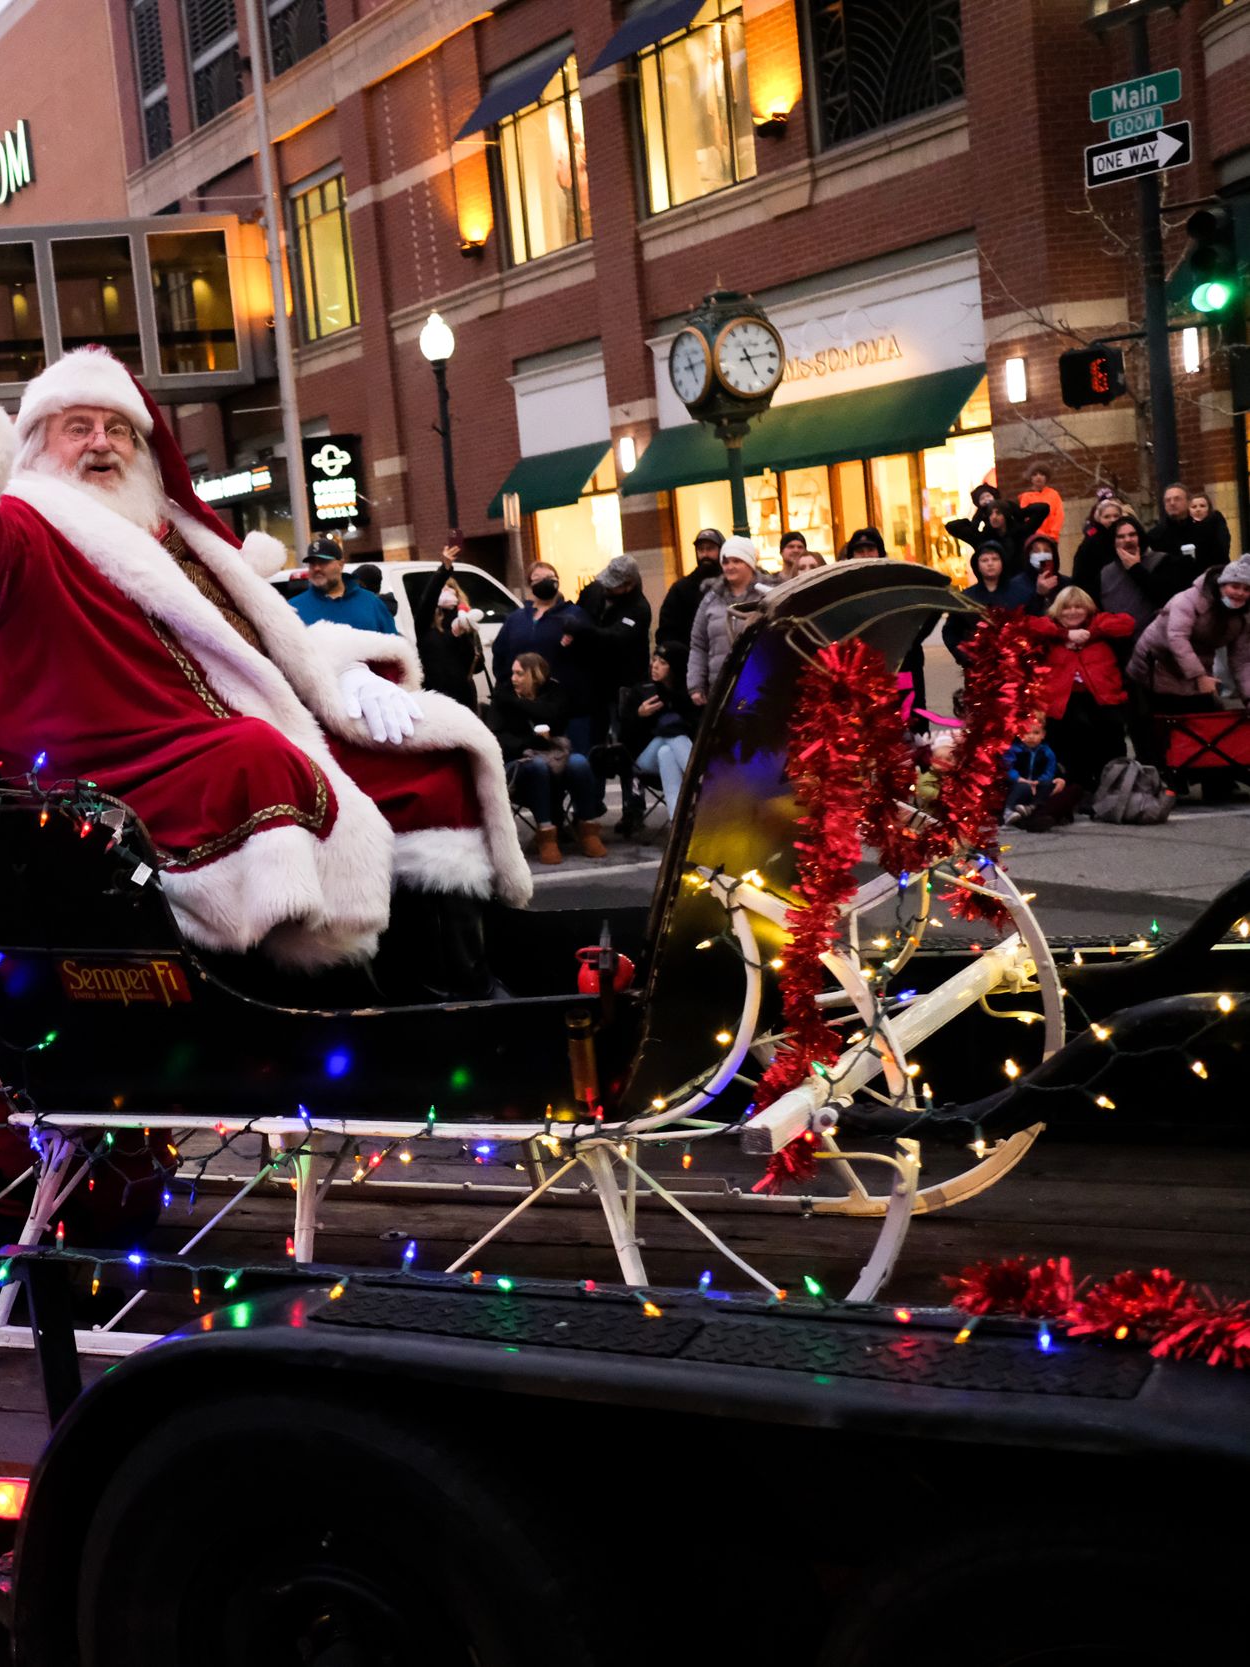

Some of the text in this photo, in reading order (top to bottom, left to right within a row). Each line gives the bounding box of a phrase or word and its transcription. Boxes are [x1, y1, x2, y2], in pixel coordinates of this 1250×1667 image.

[1111, 83, 1158, 113] Main
[1115, 112, 1156, 136] 800W
[1096, 143, 1158, 172] ONE WAY
[61, 960, 179, 1008] Semper Fi
